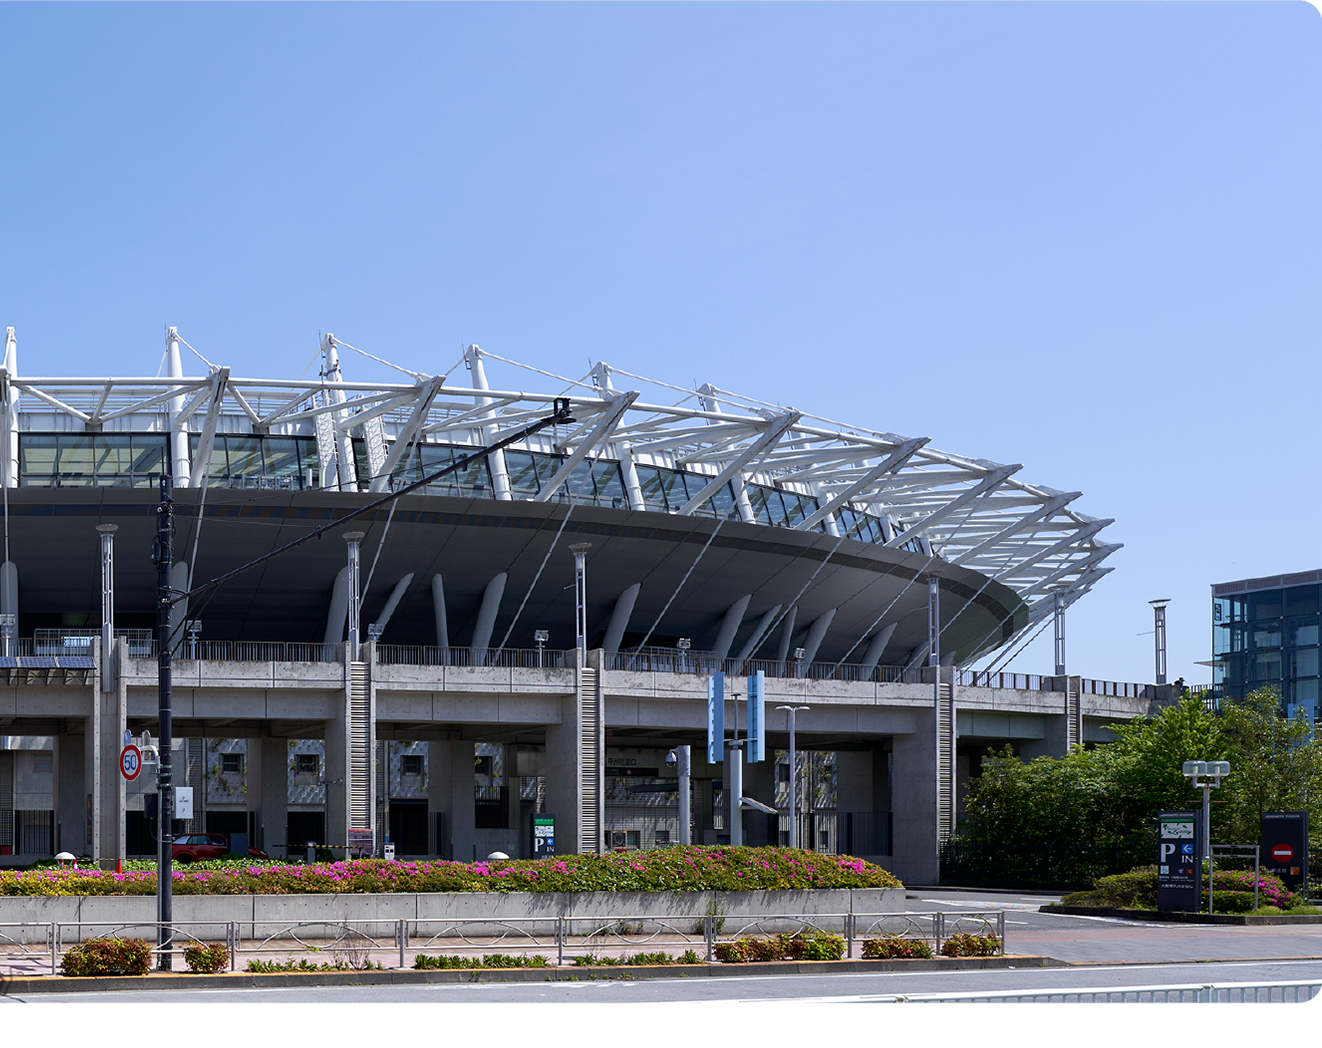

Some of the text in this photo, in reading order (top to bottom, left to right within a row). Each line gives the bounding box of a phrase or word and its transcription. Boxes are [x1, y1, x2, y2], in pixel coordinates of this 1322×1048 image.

[124, 754, 137, 771] 50
[534, 837, 545, 852] P
[1160, 843, 1176, 863] P
[1181, 855, 1194, 864] IN
